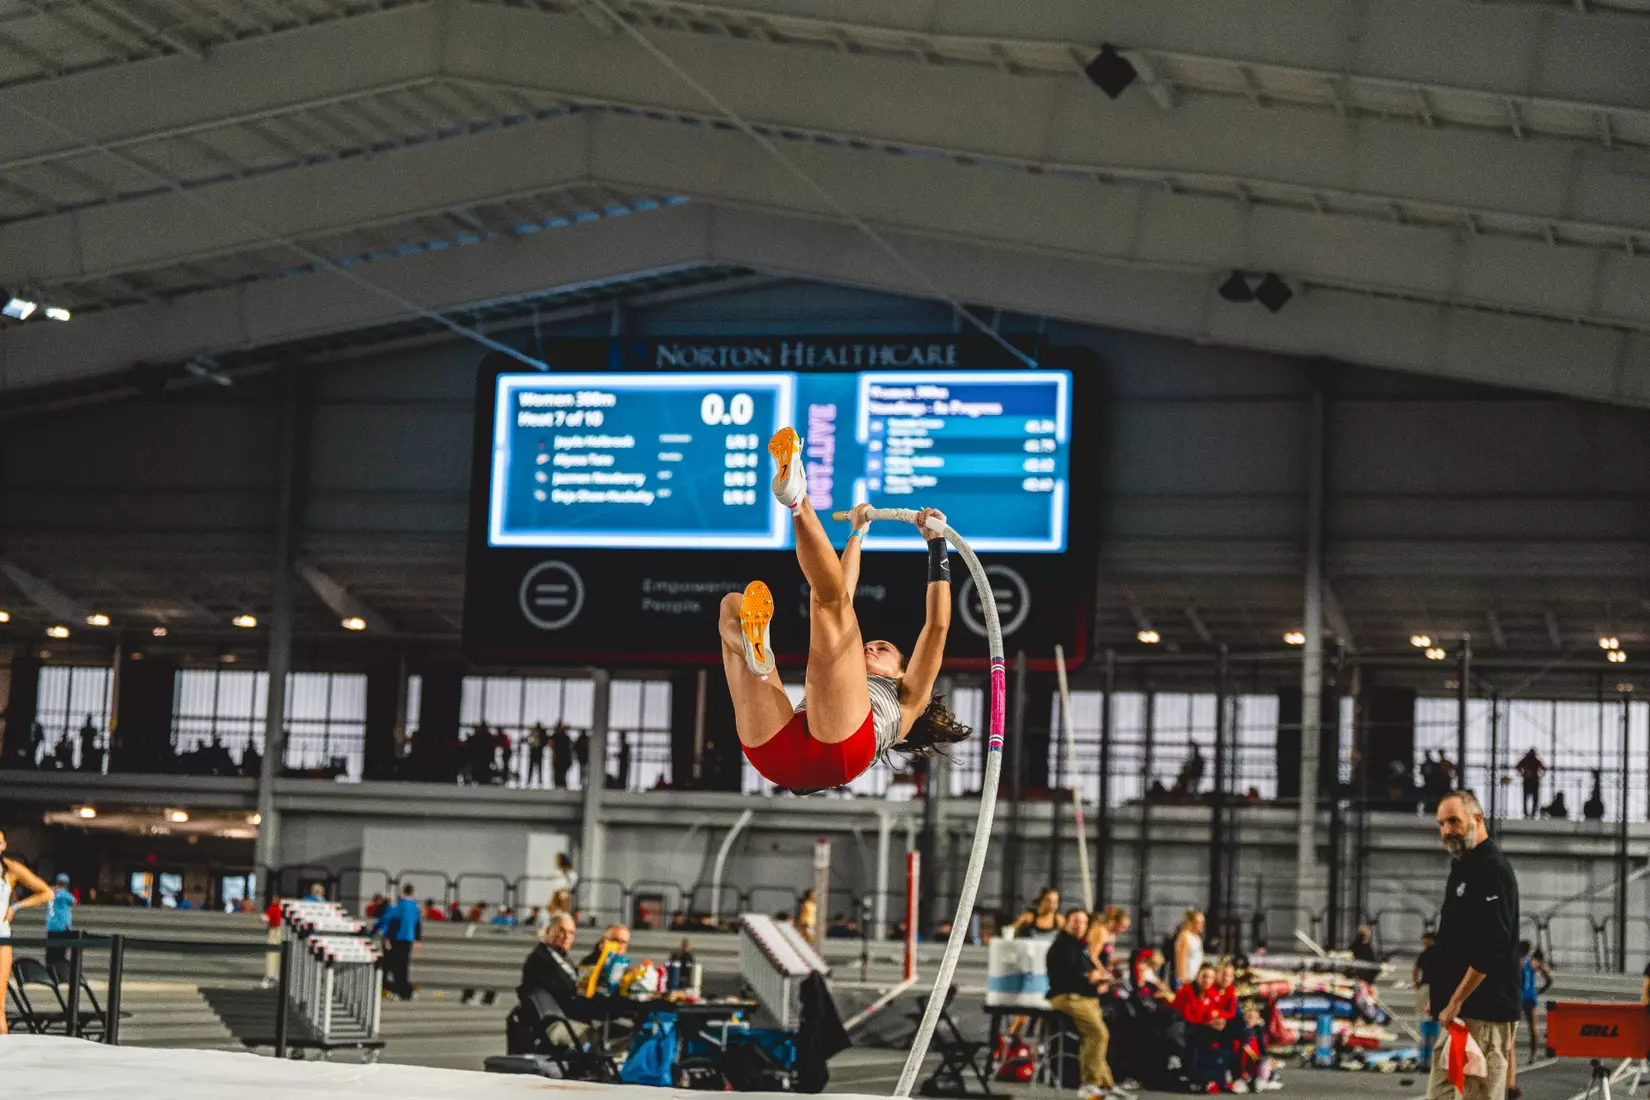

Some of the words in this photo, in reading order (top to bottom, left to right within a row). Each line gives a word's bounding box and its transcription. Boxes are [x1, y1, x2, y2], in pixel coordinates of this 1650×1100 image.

[656, 343, 772, 368] NORTON
[779, 341, 957, 367] HEALTHCARE
[700, 393, 754, 426] 0.0
[642, 577, 748, 594] Empowerin
[1580, 1024, 1619, 1037] GILL
